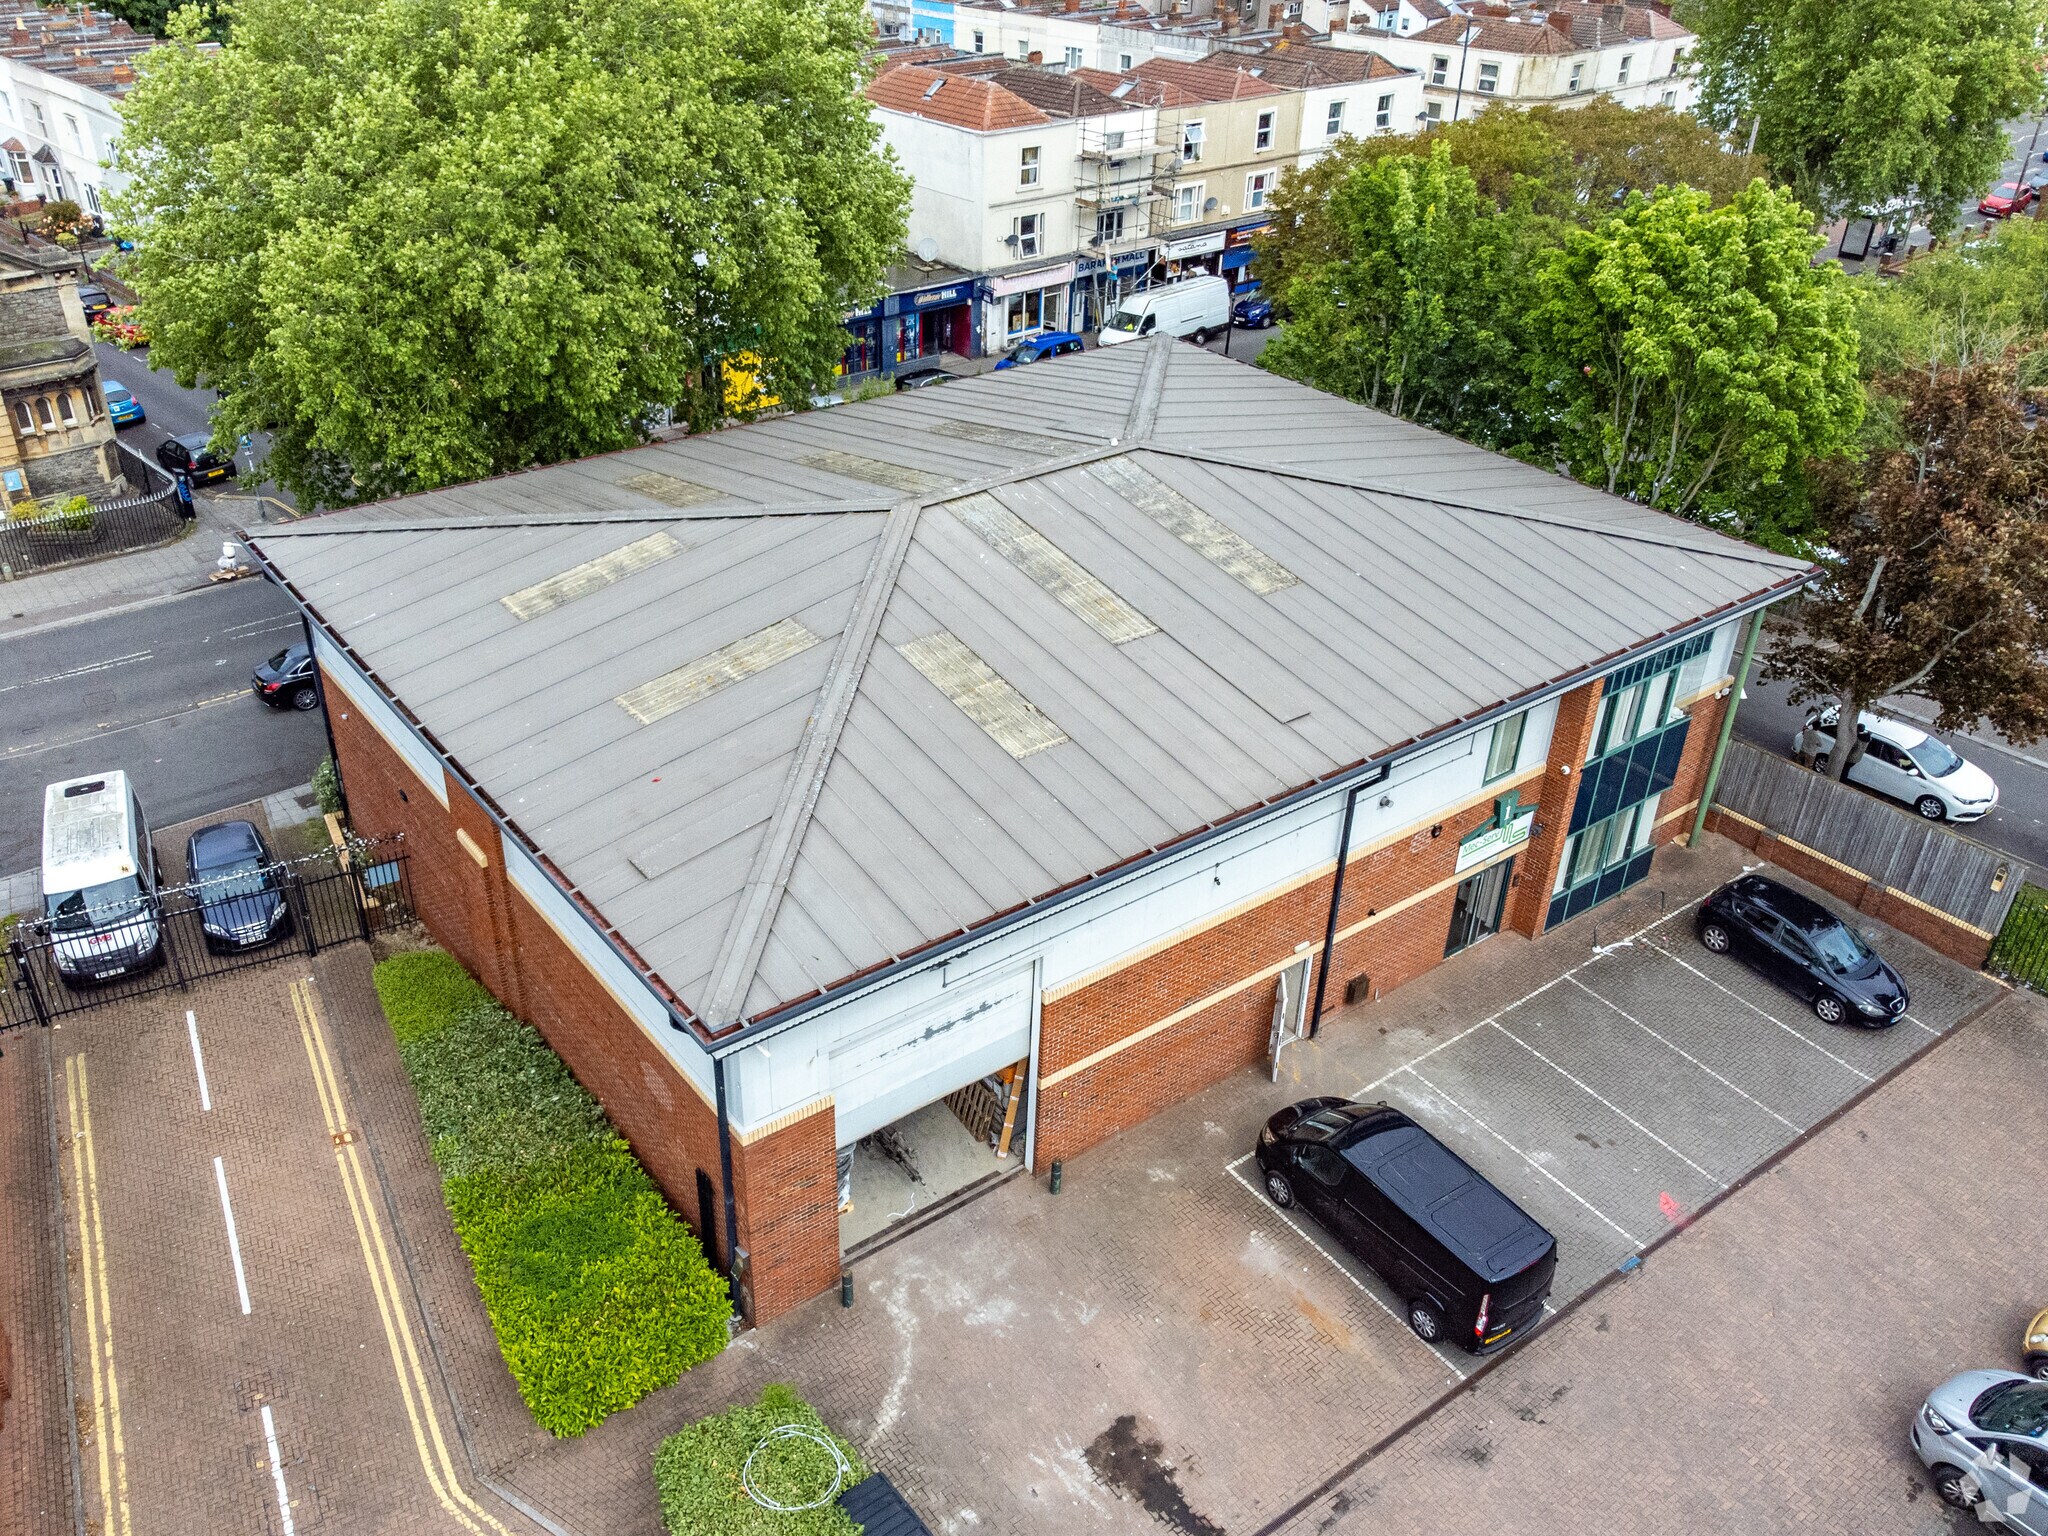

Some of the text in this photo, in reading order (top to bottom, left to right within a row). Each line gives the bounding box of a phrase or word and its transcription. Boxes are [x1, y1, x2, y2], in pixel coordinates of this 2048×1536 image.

[1078, 251, 1145, 272] BARAH MALL
[941, 289, 957, 300] HILL
[89, 933, 112, 945] GMB
